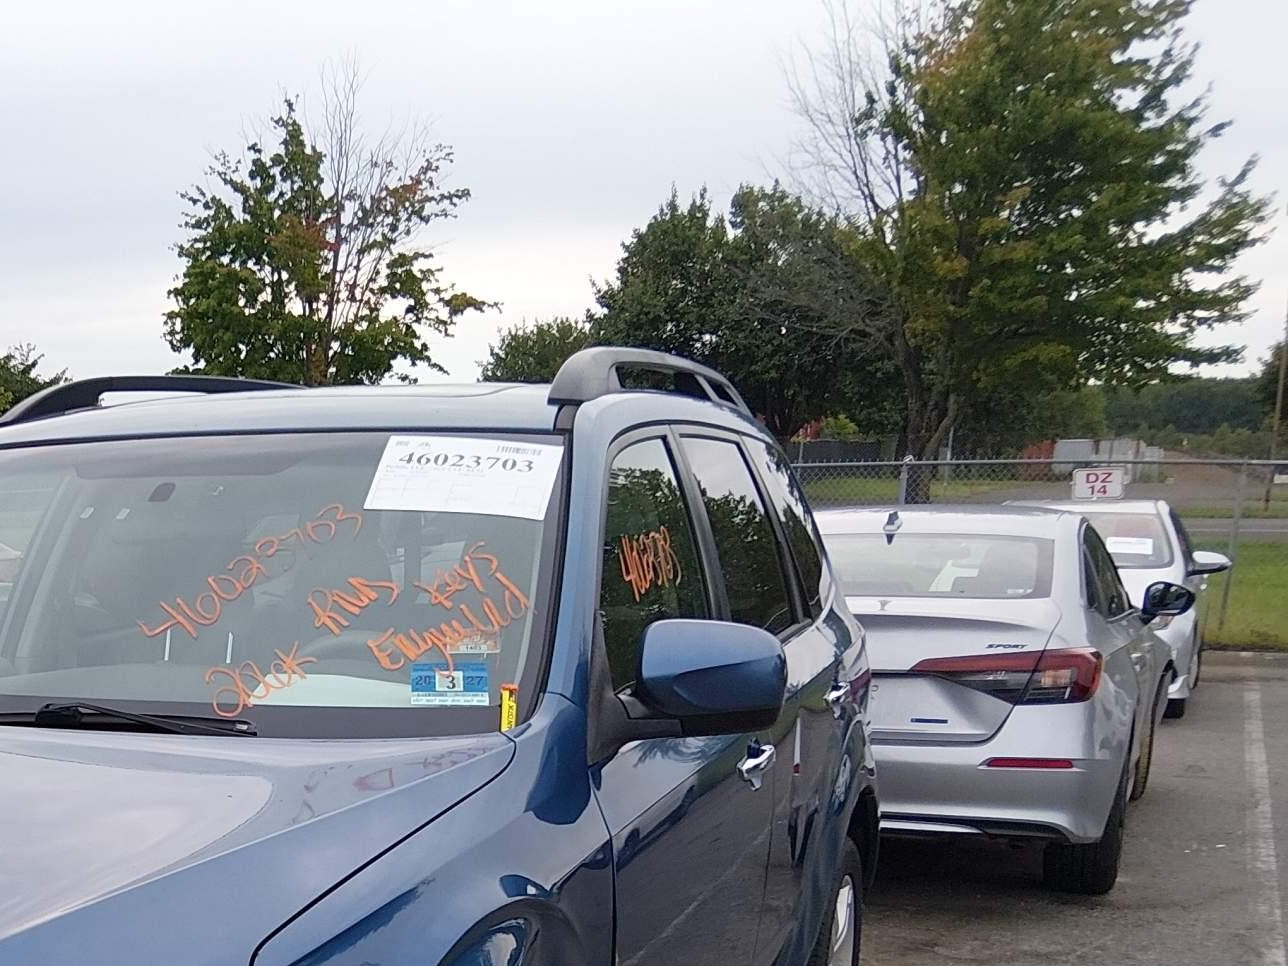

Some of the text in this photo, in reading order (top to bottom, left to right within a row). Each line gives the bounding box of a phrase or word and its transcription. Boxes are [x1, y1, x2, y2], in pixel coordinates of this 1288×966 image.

[398, 451, 535, 473] 46023703
[1085, 472, 1113, 484] DZ
[1088, 484, 1108, 495] 14
[415, 674, 484, 690] 20 3 27
